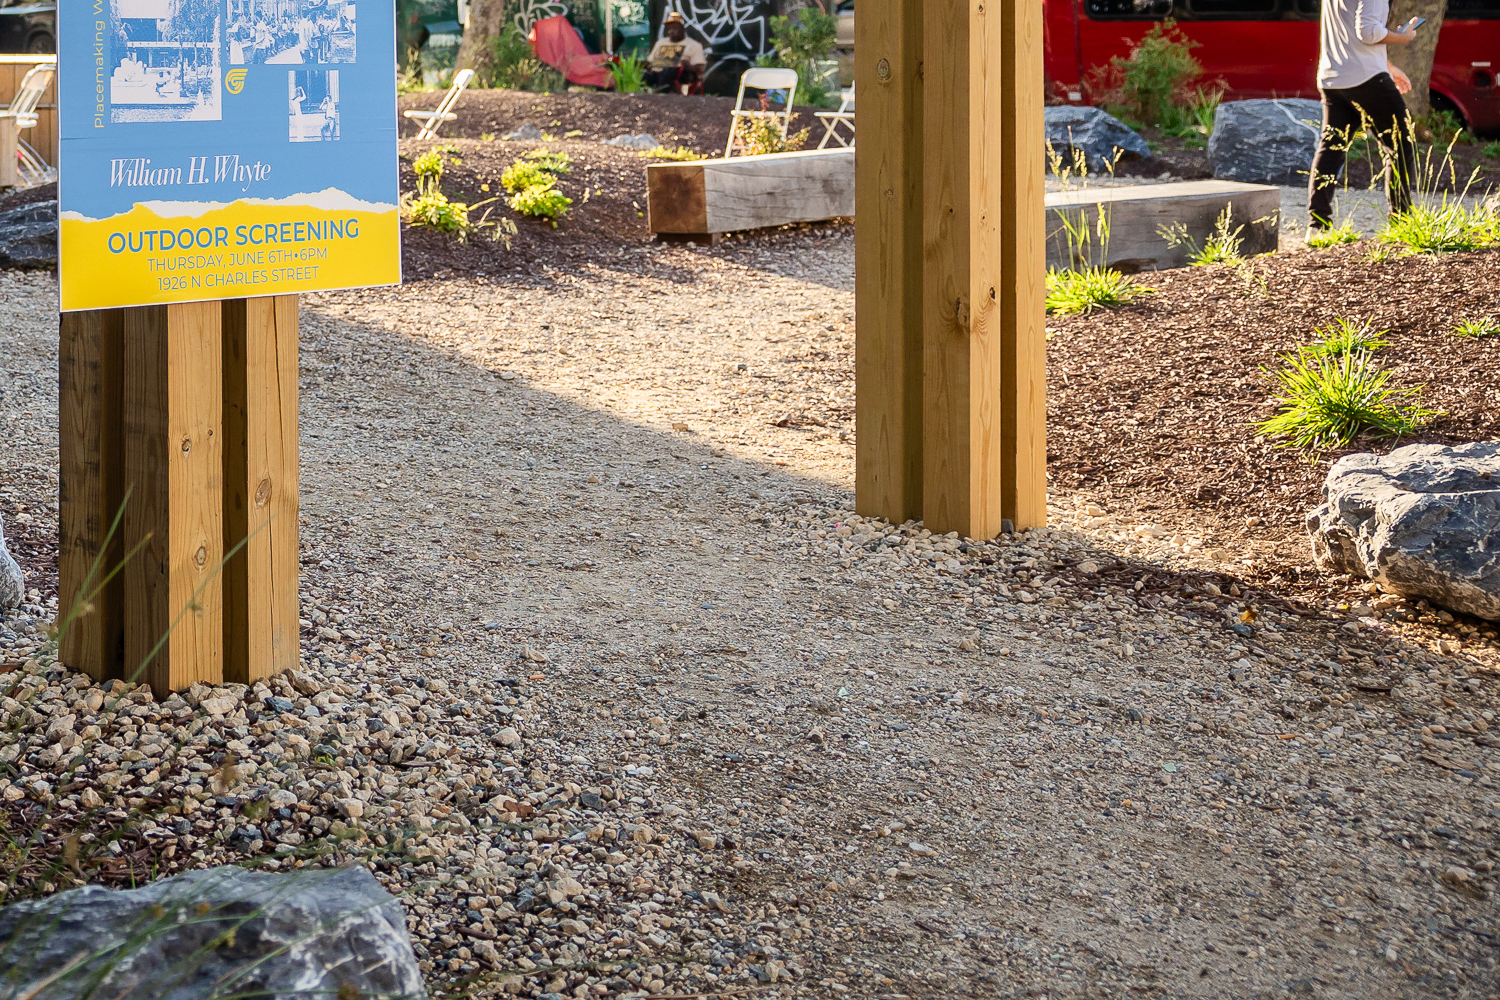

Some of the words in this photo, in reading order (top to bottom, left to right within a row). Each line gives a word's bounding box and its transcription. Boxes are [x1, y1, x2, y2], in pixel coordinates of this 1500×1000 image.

[93, 20, 106, 128] Placemaking
[110, 158, 183, 188] William
[186, 156, 210, 185] H.
[214, 154, 272, 192] Whyte
[108, 226, 229, 254] OUTDOOR
[235, 218, 359, 247] SCREENING
[147, 254, 226, 272] THURSDAY,
[228, 251, 265, 267] JUNE
[157, 276, 187, 291] 1926
[191, 275, 201, 289] N
[205, 269, 268, 287] CHARLES
[271, 266, 320, 282] STREET
